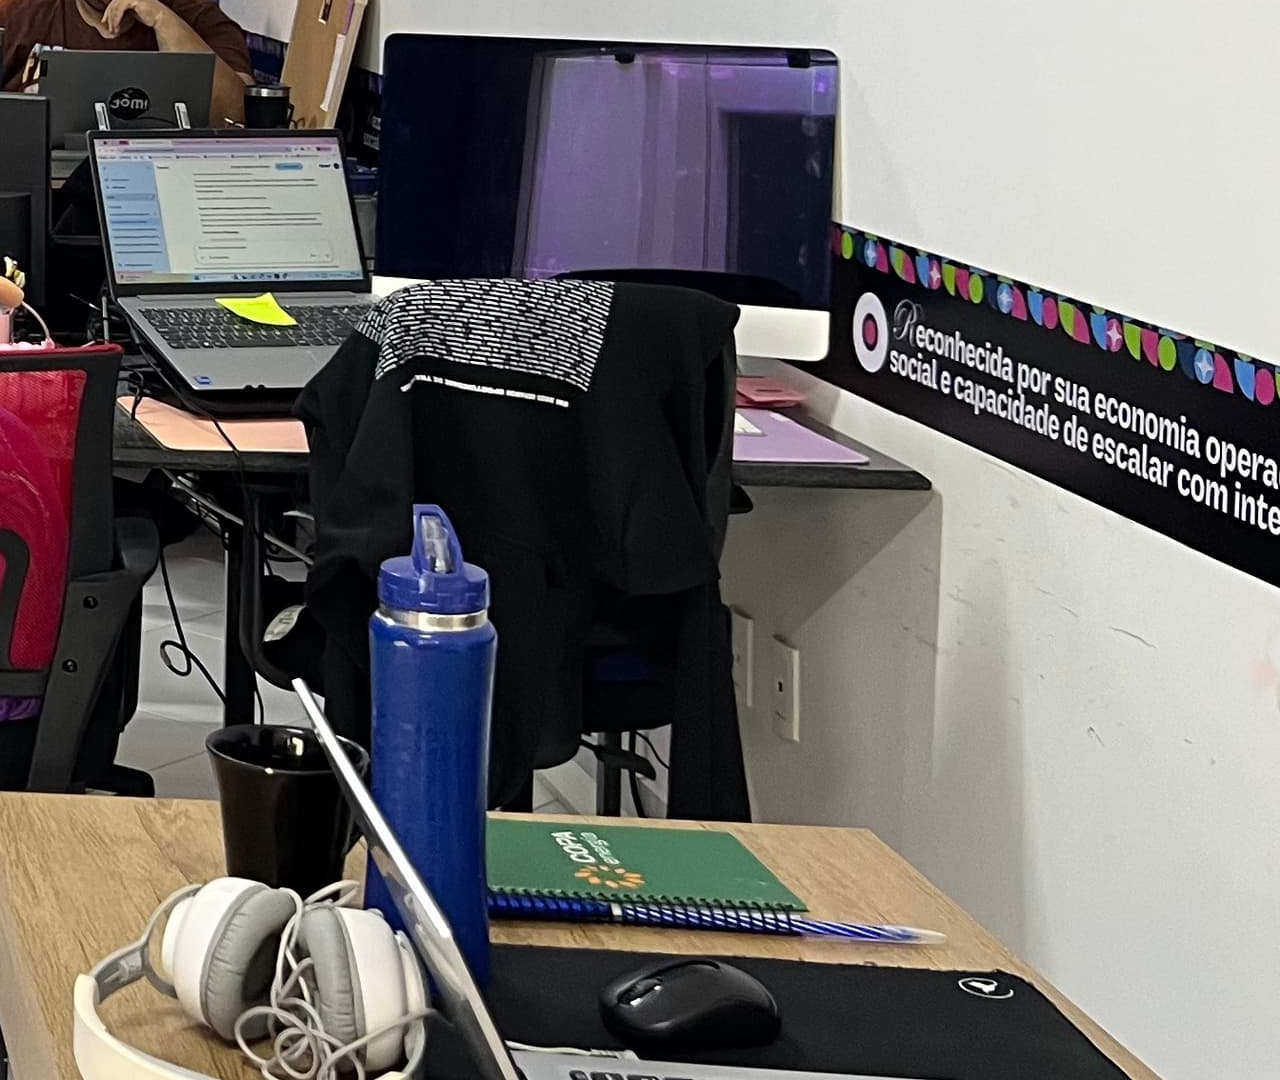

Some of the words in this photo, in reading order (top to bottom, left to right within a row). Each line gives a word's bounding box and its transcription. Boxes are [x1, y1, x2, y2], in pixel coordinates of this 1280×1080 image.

[890, 350, 938, 391] social
[940, 370, 952, 395] e
[953, 375, 1060, 440] capacidade
[1063, 415, 1089, 453] de
[1092, 432, 1174, 488] escalar
[1177, 468, 1228, 514] com
[1233, 480, 1280, 536] inte
[892, 299, 1014, 383] Reconhecida
[1017, 362, 1051, 396] por
[1054, 376, 1091, 414] sua
[1094, 392, 1201, 459] economia
[1205, 435, 1280, 490] opera
[550, 831, 596, 863] COPA
